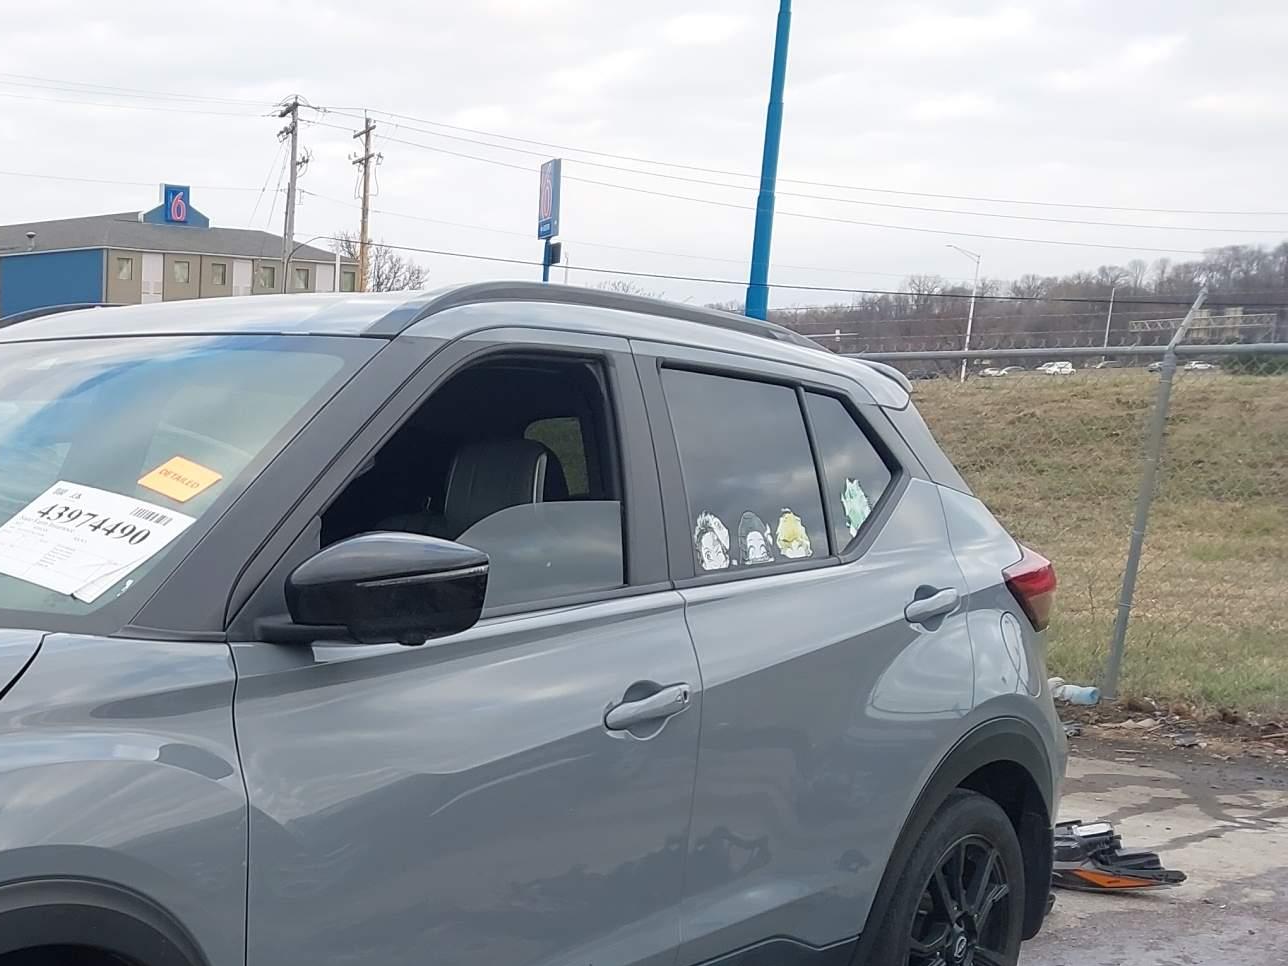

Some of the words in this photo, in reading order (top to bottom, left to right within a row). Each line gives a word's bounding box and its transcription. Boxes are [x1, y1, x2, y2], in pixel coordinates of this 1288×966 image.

[171, 191, 186, 221] 6
[158, 468, 200, 490] DETAILED
[37, 503, 151, 546] 43974490
